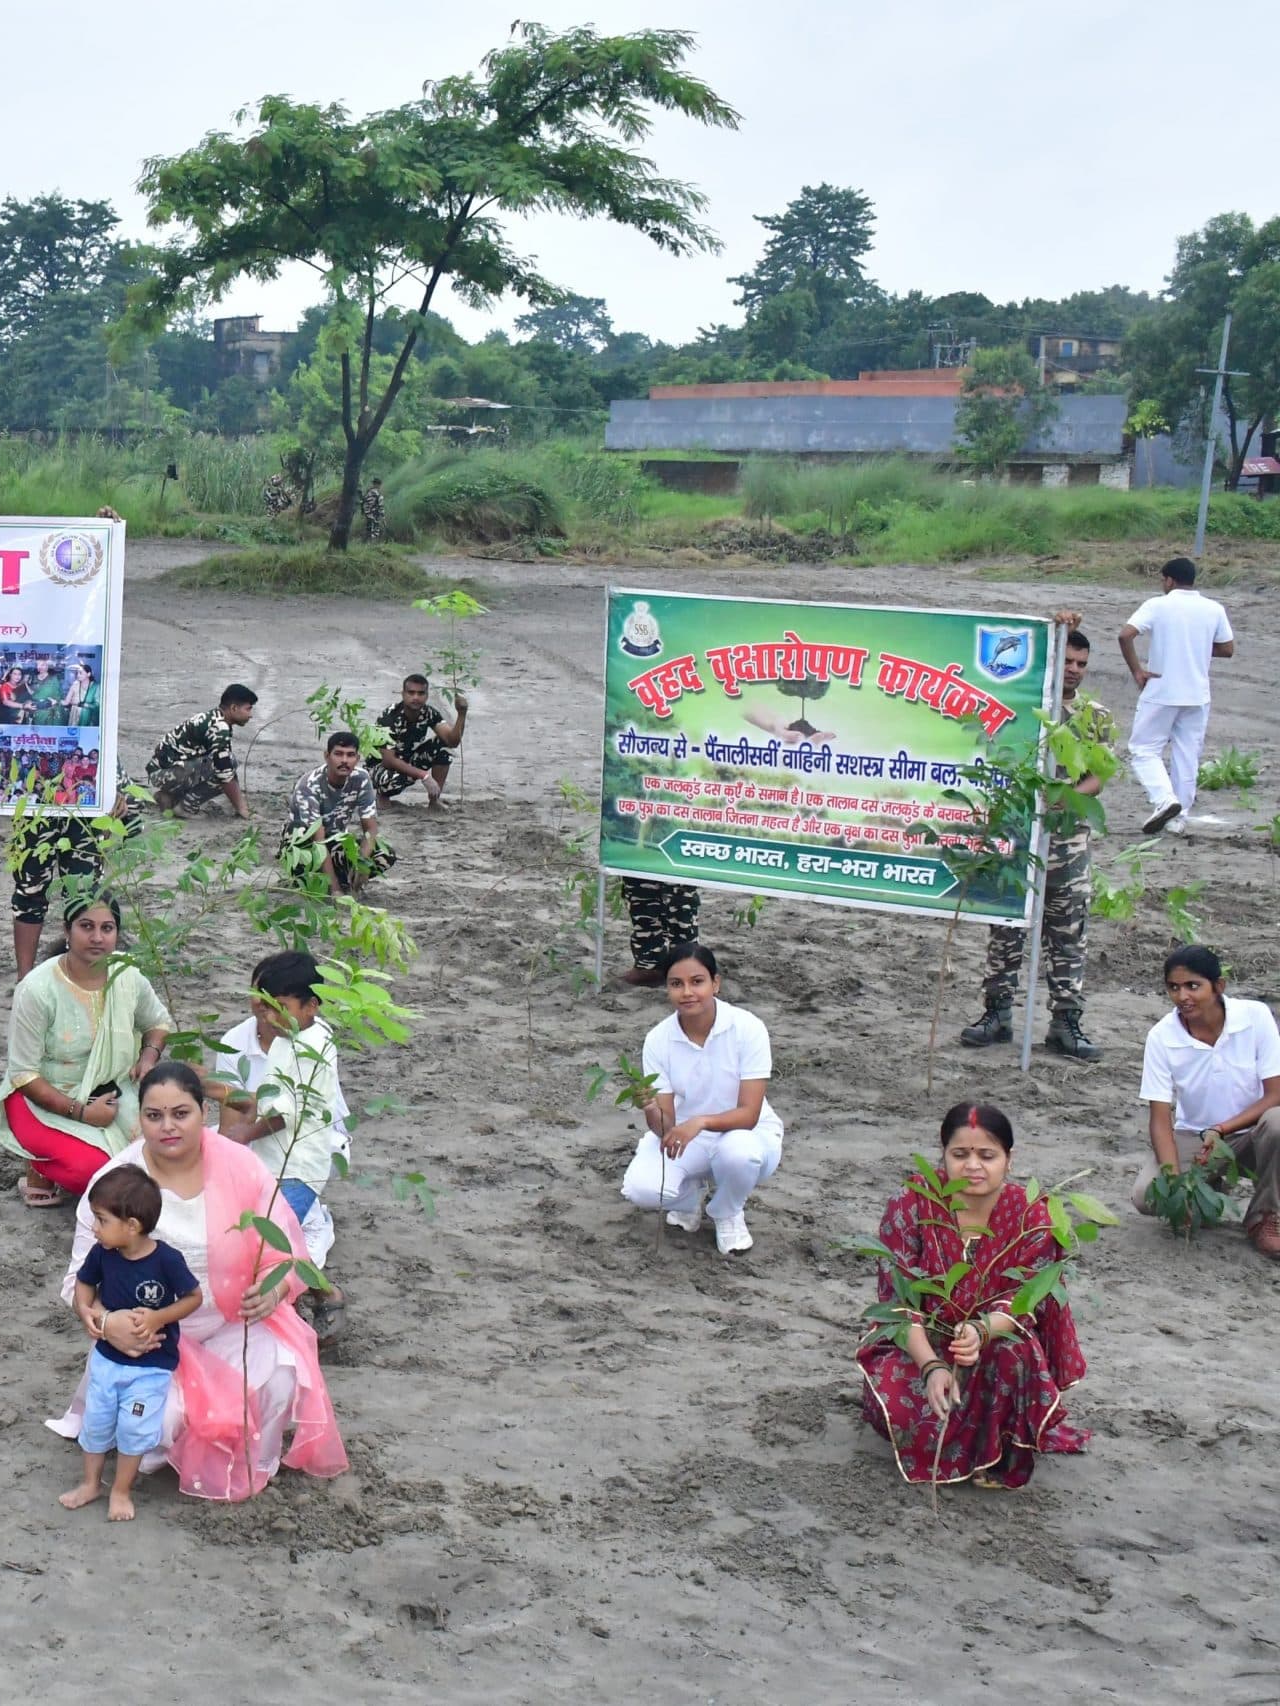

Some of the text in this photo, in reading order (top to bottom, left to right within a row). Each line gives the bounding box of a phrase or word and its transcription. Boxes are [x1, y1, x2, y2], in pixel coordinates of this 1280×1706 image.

[634, 623, 649, 636] SSB
[628, 631, 1017, 738] वृहद वृक्षारोपण कार्यक्रम
[618, 727, 670, 757] सौजन्य
[673, 733, 688, 759] से
[782, 741, 832, 773] वाहिनी
[835, 754, 884, 778] सशस्त्र
[889, 750, 927, 781] सीमा
[618, 800, 636, 813] एक
[639, 801, 654, 820] पुत्र
[656, 804, 671, 816] का
[673, 805, 690, 819] दस
[692, 807, 723, 822] तालाब
[725, 807, 758, 826] जितना
[761, 816, 789, 830] महत्व
[802, 816, 821, 834] और
[823, 823, 841, 837] एक
[844, 827, 861, 844] वृक्ष
[863, 828, 878, 841] का
[881, 831, 899, 842] दस
[644, 777, 661, 790] एक
[704, 782, 721, 796] दस
[744, 783, 756, 799] के
[758, 788, 788, 801] समान
[806, 793, 823, 807] एक
[826, 795, 858, 810] तालाब
[861, 800, 878, 813] दस
[923, 801, 935, 819] के
[937, 807, 970, 823] बराबर
[680, 839, 937, 886] स्वच्छ भारत, हरा-भरा भारत
[143, 1285, 158, 1299] M
